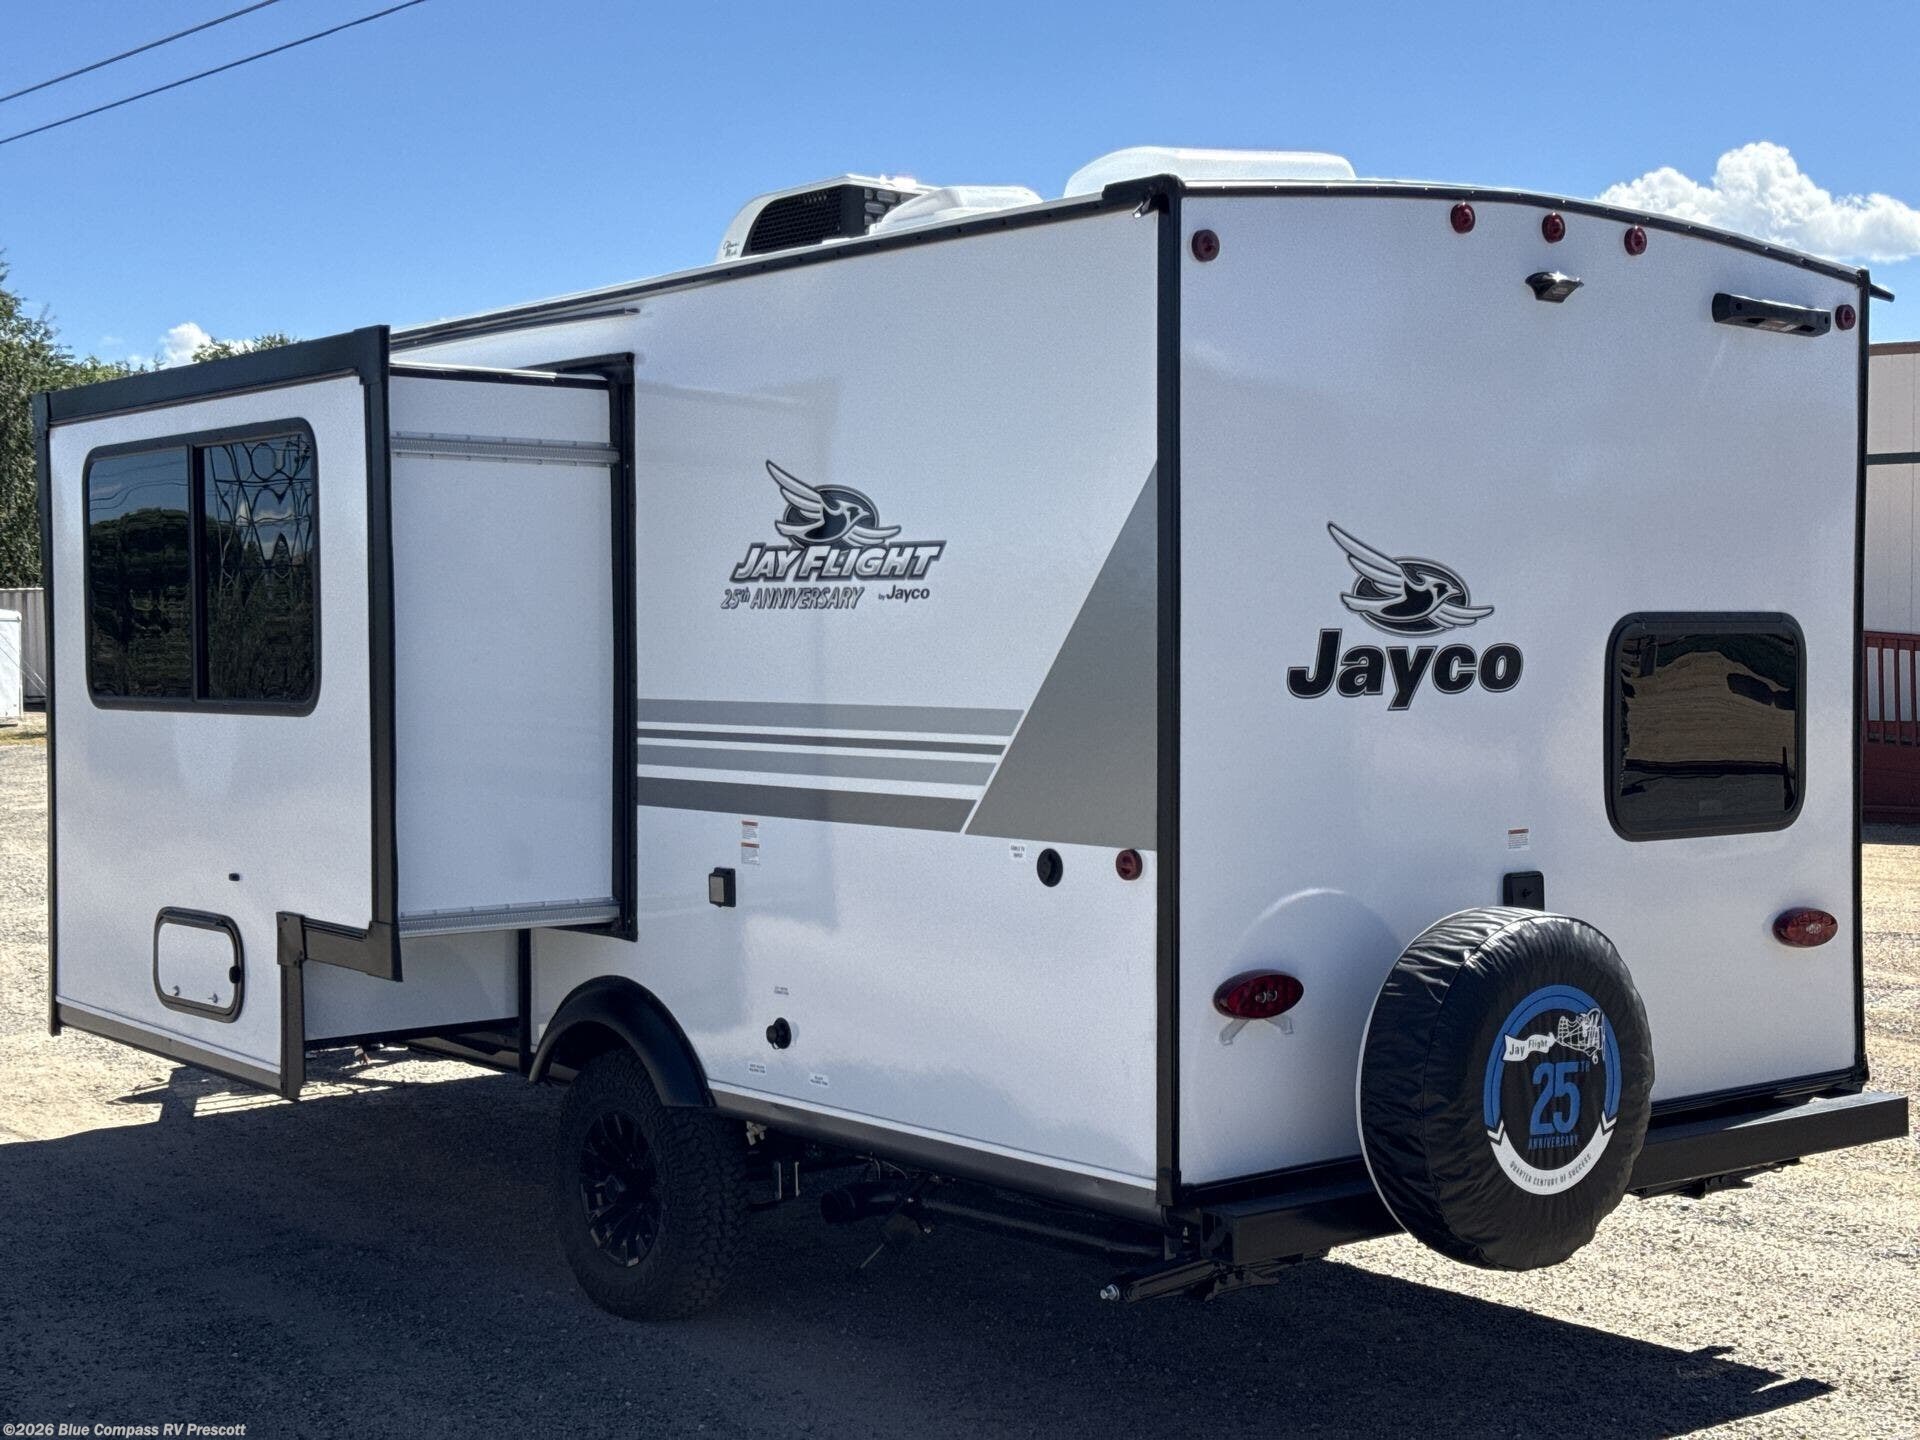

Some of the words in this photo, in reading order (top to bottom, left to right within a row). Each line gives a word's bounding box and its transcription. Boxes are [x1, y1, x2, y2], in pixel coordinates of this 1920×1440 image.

[750, 587, 865, 609] ANNIVERSARY
[886, 585, 930, 603] Jayco
[1286, 627, 1524, 711] Jayco
[1509, 1044, 1525, 1057] Jay
[1528, 1039, 1548, 1050] Flight
[1528, 1135, 1578, 1150] ANNIVERSARY
[1509, 1160, 1532, 1183] QUARTER
[1533, 1177, 1558, 1187] CENTURY
[1568, 1153, 1591, 1179] SUCCESS
